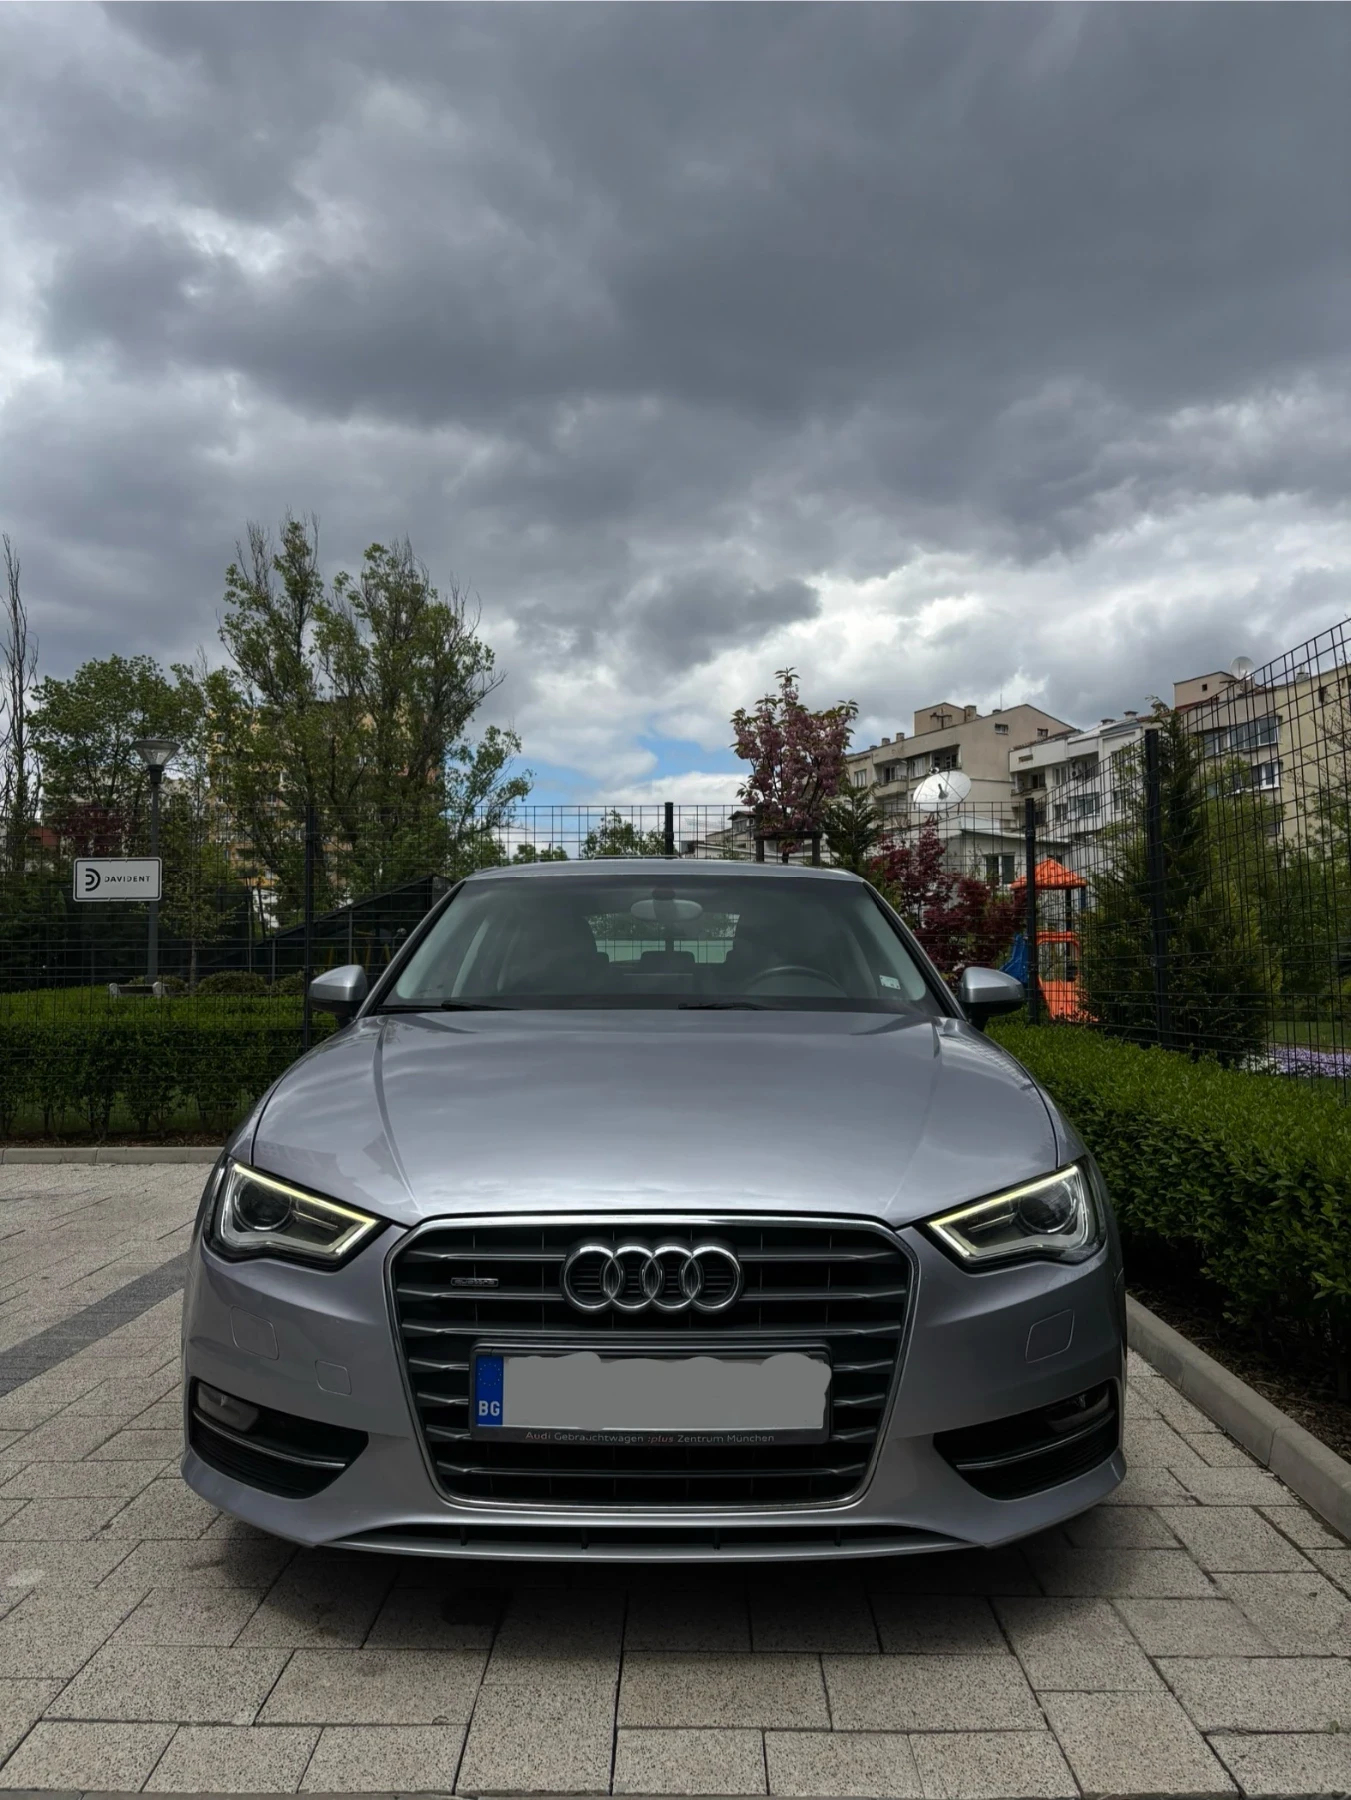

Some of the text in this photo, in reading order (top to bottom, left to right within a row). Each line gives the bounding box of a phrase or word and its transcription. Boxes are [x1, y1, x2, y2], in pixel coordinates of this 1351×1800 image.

[478, 1400, 500, 1417] BG
[525, 1431, 551, 1440] Audi
[554, 1432, 644, 1444] Gebrauchtwagen
[677, 1434, 724, 1443] Zentrum
[727, 1434, 775, 1443] München
